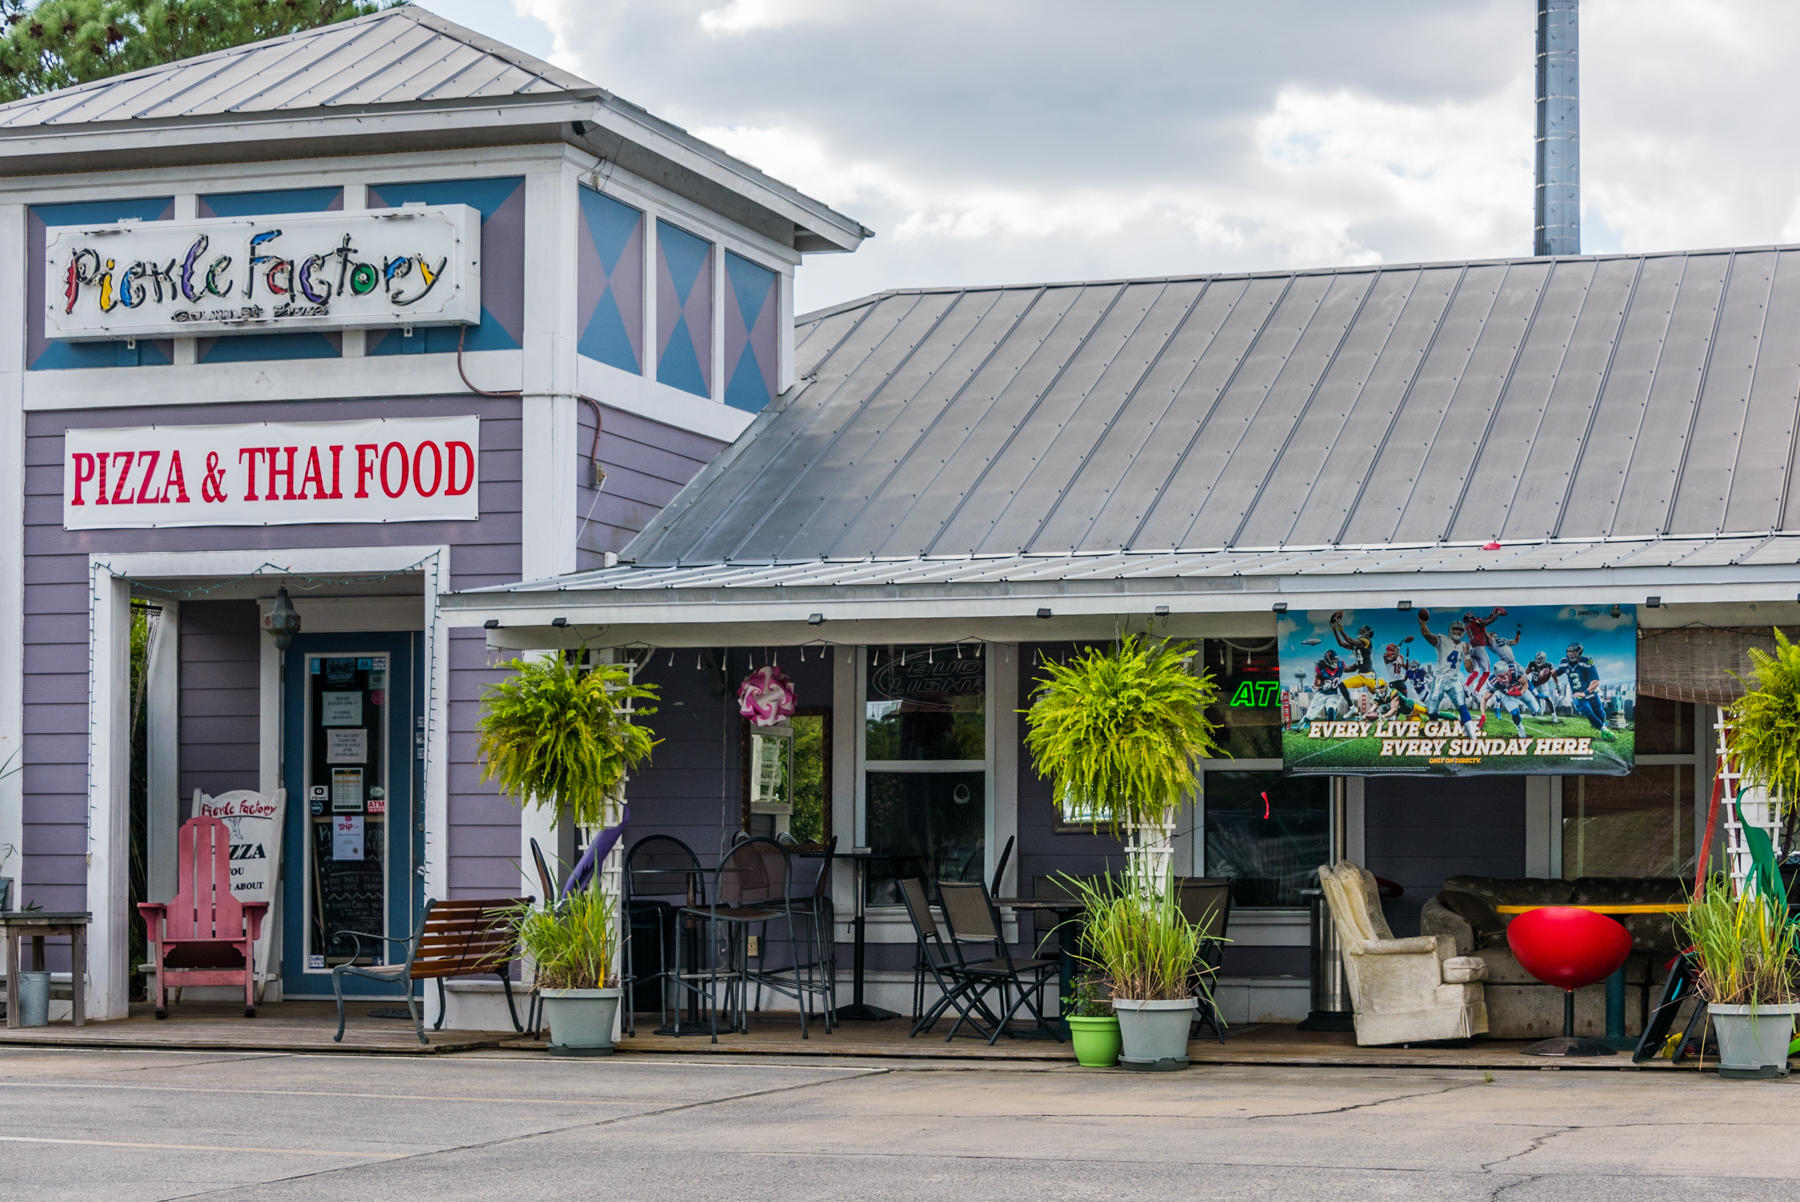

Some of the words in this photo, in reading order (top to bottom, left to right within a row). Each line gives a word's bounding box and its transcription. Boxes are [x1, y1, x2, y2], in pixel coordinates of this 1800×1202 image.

[65, 234, 233, 314] Pickle
[247, 229, 447, 307] Factory
[71, 450, 191, 506] PIZZA
[201, 451, 228, 503] &
[239, 445, 343, 501] THAI
[354, 440, 475, 499] FOOD
[1308, 721, 1372, 738] EVERY
[1374, 721, 1421, 738] LIVE
[1380, 739, 1447, 756] EVERY
[1448, 738, 1533, 756] SUNDAY
[1534, 738, 1594, 756] HERE.
[239, 800, 278, 816] Factory
[212, 842, 266, 860] ZZA
[229, 867, 244, 876] OU
[234, 882, 264, 890] ABOUT
